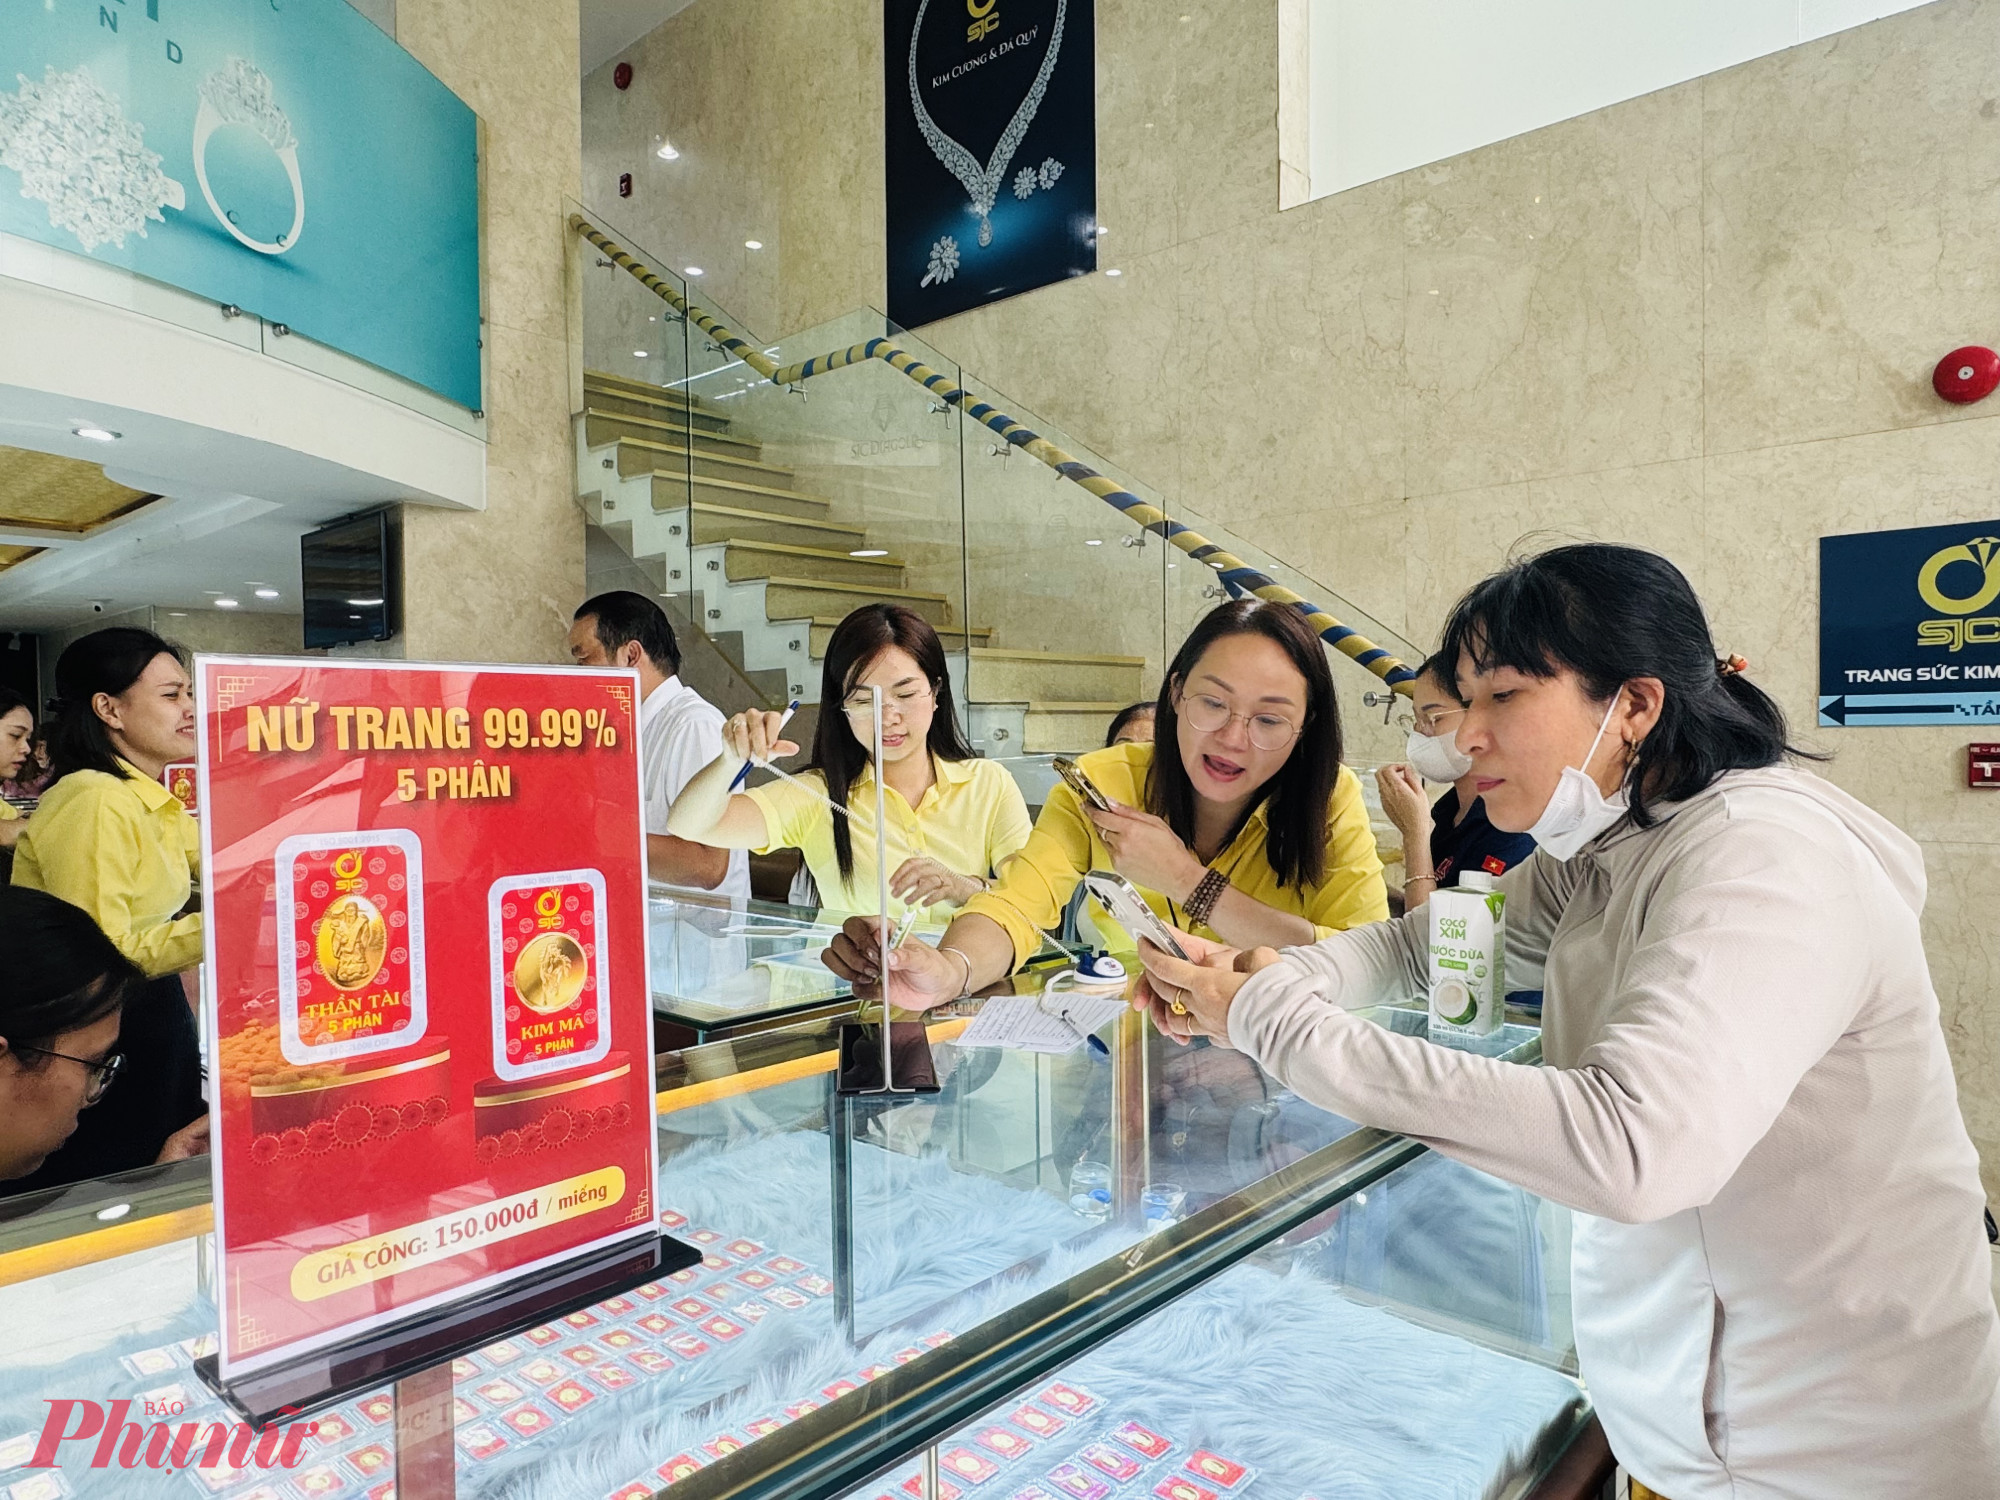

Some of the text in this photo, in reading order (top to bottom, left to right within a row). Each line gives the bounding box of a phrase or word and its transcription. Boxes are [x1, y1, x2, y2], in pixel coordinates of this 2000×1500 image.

[967, 12, 999, 43] SJC
[932, 72, 950, 89] KIM
[989, 47, 998, 60] &
[1917, 617, 2000, 652] SJC
[1845, 664, 2000, 683] TRANG SỨC KIM
[246, 697, 617, 753] NỮ TRANG 99.99%
[397, 759, 512, 802] 5 PHÂN
[335, 879, 363, 892] SJC
[538, 917, 562, 929] SJC
[1440, 926, 1466, 941] XIM
[1459, 947, 1484, 960] DỪA
[305, 989, 400, 1020] THẦN TÀI
[328, 1011, 382, 1034] 5 PHÂN
[521, 1013, 585, 1041] KIM MÃ
[535, 1036, 575, 1055] 5 PHÂN
[317, 1183, 609, 1285] GIÁ CÔNG: 150.000đ / miếng
